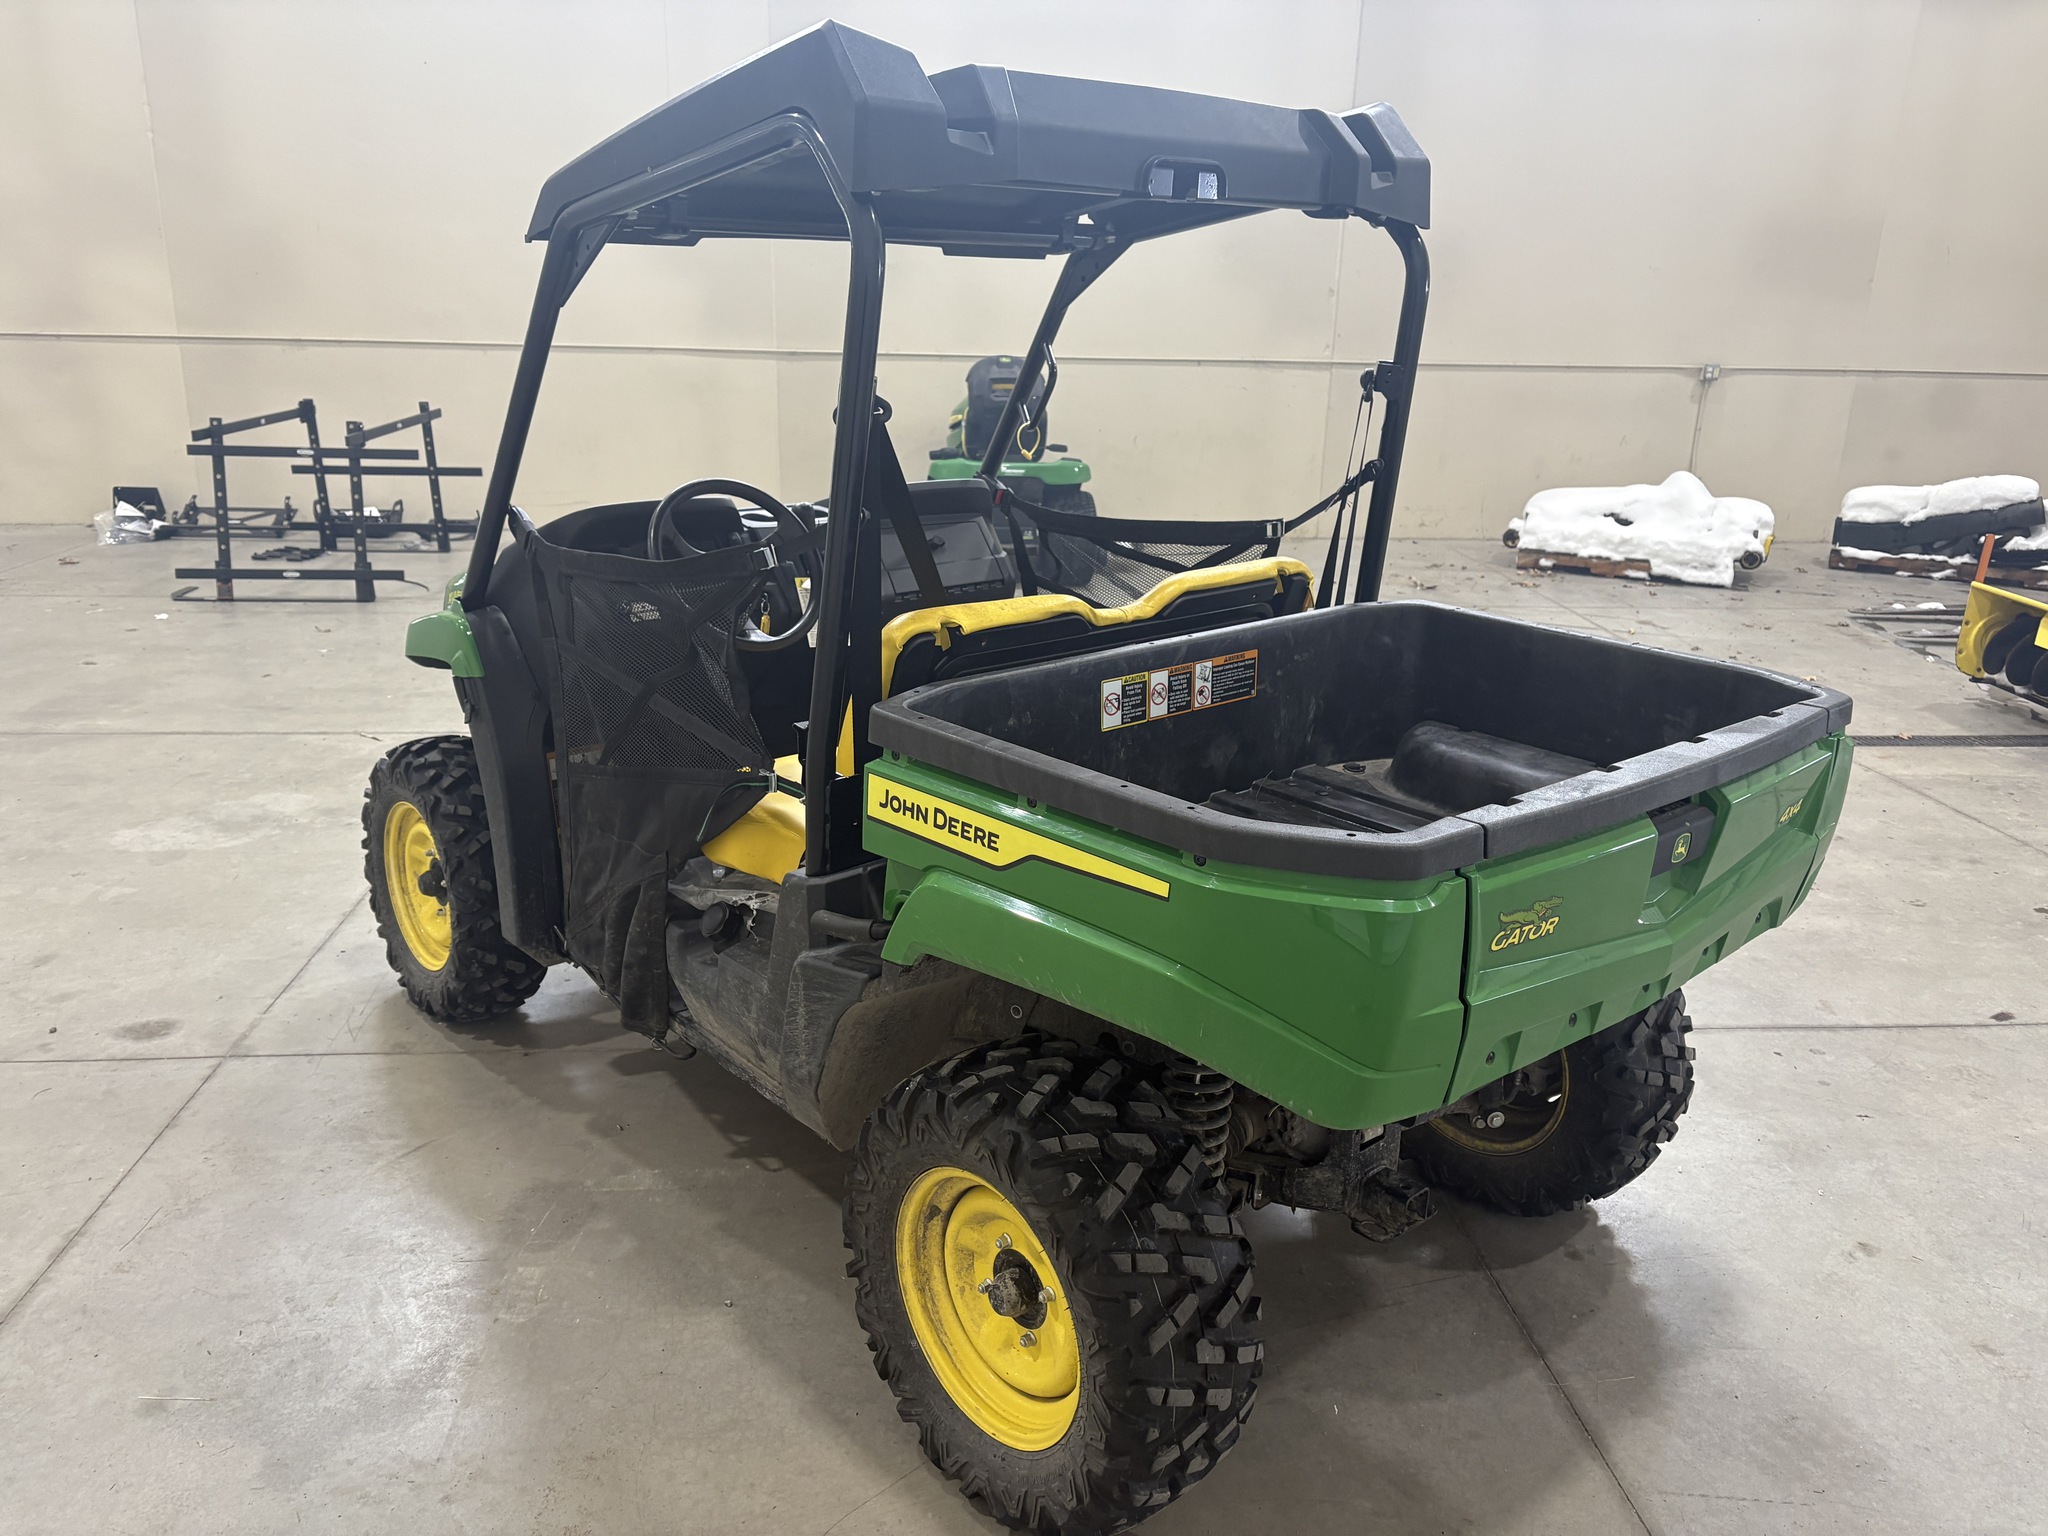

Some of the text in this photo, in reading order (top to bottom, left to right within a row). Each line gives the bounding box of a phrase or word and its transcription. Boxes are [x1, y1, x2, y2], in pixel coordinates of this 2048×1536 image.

[1228, 653, 1246, 662] WARNING
[1174, 664, 1193, 673] WARNING
[1128, 674, 1146, 683] CAUTION
[879, 789, 1000, 853] JOHN DEERE
[1490, 916, 1560, 952] GATOR
